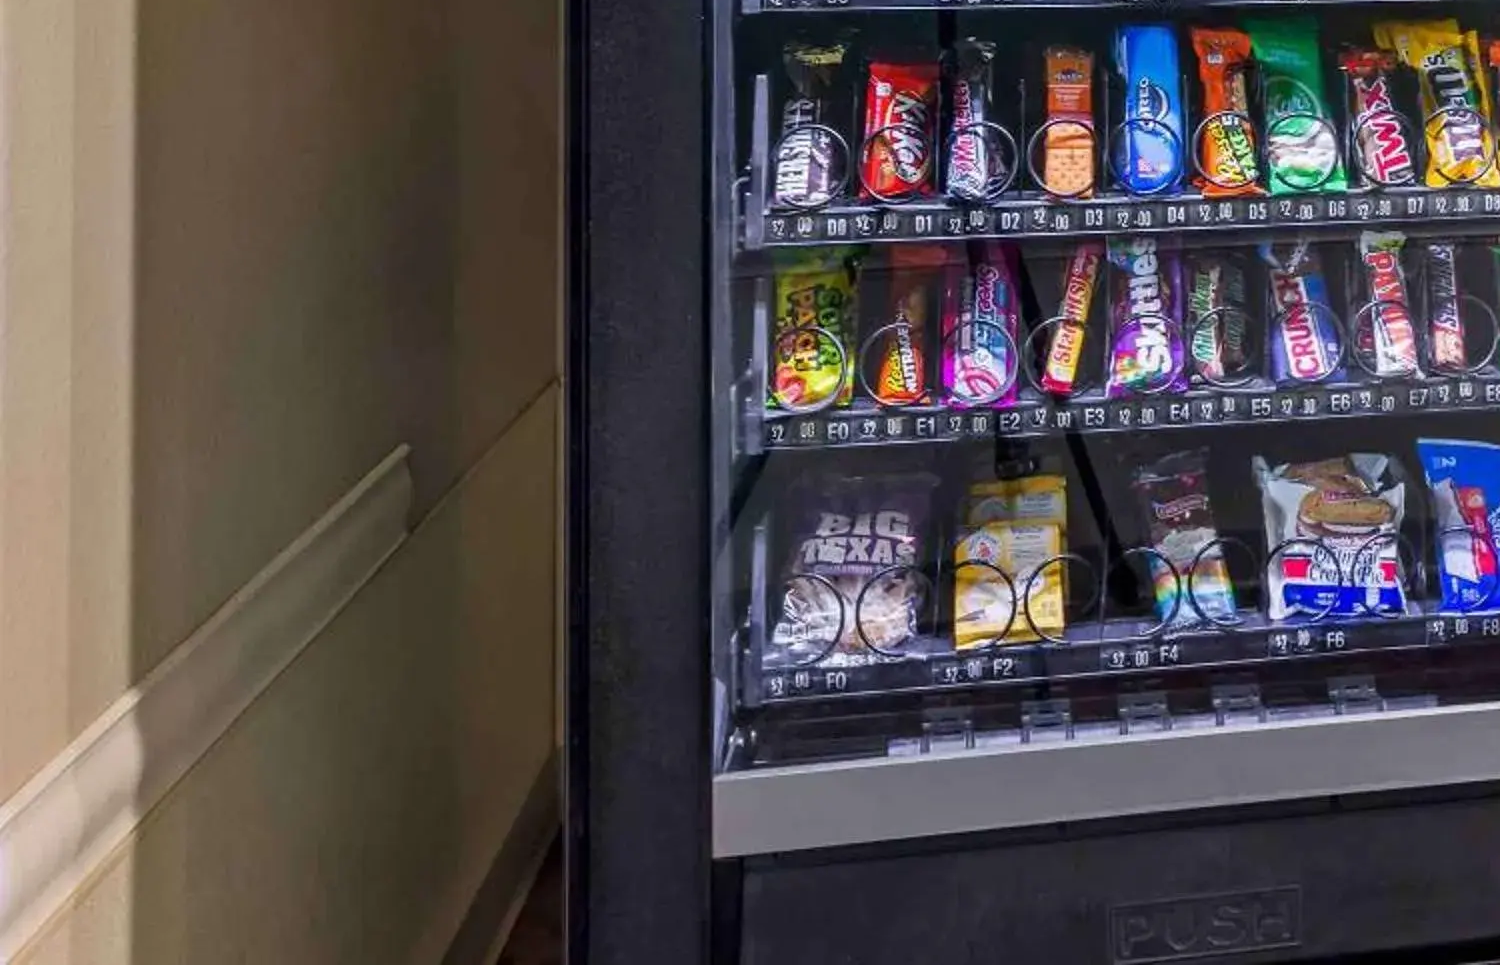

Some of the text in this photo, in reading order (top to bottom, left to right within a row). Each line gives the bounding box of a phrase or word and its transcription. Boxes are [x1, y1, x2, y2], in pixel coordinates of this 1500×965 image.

[1137, 77, 1150, 126] OREO
[1407, 197, 1424, 213] D7
[1485, 194, 1500, 210] D8
[1086, 209, 1103, 226] D3
[1168, 207, 1185, 223] D4
[1250, 203, 1267, 218] D5
[915, 216, 931, 232] D1
[1002, 213, 1019, 230] D2
[1331, 395, 1350, 411] E6
[1409, 390, 1428, 406] E7
[1170, 404, 1189, 420] E4
[1251, 399, 1271, 415] E5
[1001, 414, 1020, 430] E2
[1085, 409, 1104, 425] E3
[828, 423, 849, 439] E0
[917, 418, 935, 435] E1
[816, 511, 912, 537] BIG
[801, 536, 917, 565] TEXAS
[1483, 619, 1500, 635] F8
[1327, 632, 1345, 648] F6
[1160, 645, 1178, 663] F4
[993, 659, 1013, 676] F2
[826, 673, 846, 689] F0
[1119, 901, 1291, 957] PUSH
